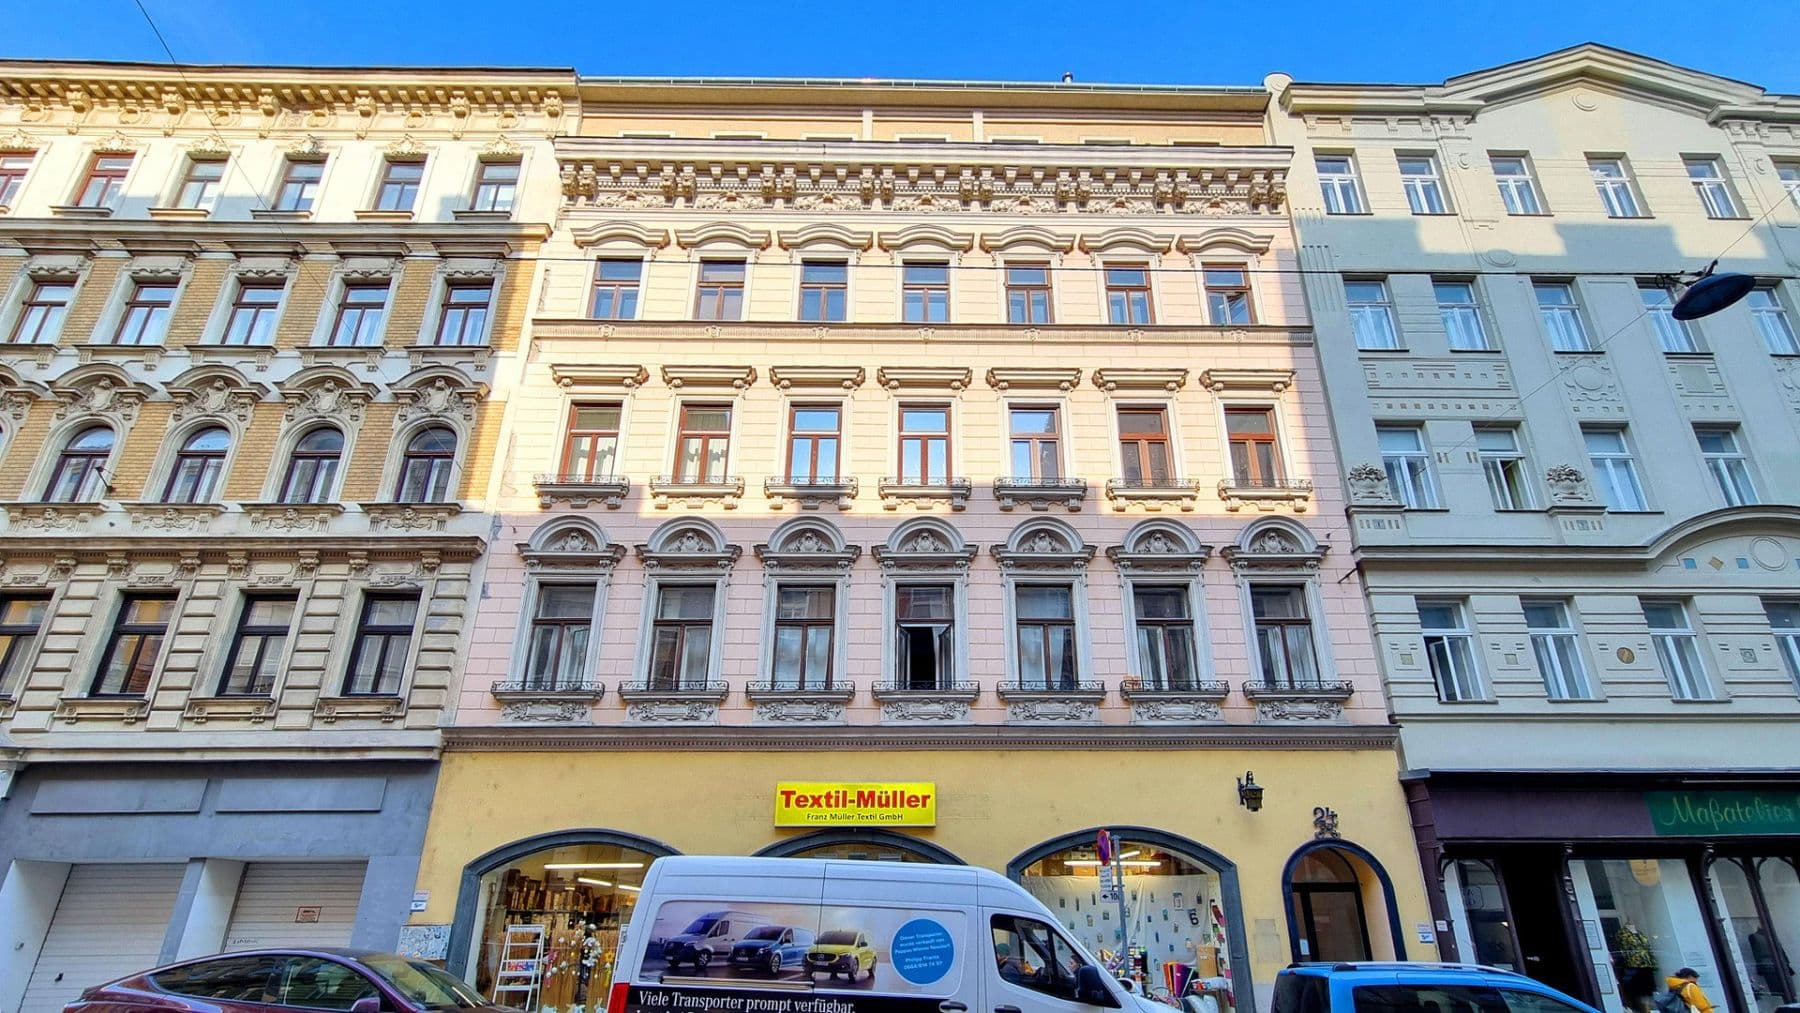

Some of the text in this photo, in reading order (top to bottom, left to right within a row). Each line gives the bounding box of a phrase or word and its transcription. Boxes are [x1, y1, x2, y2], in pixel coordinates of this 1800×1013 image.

[780, 790, 931, 808] Textil-Müller
[829, 812, 855, 820] Müller
[639, 990, 856, 1013] Viele Transporter prompt verfügbar.
